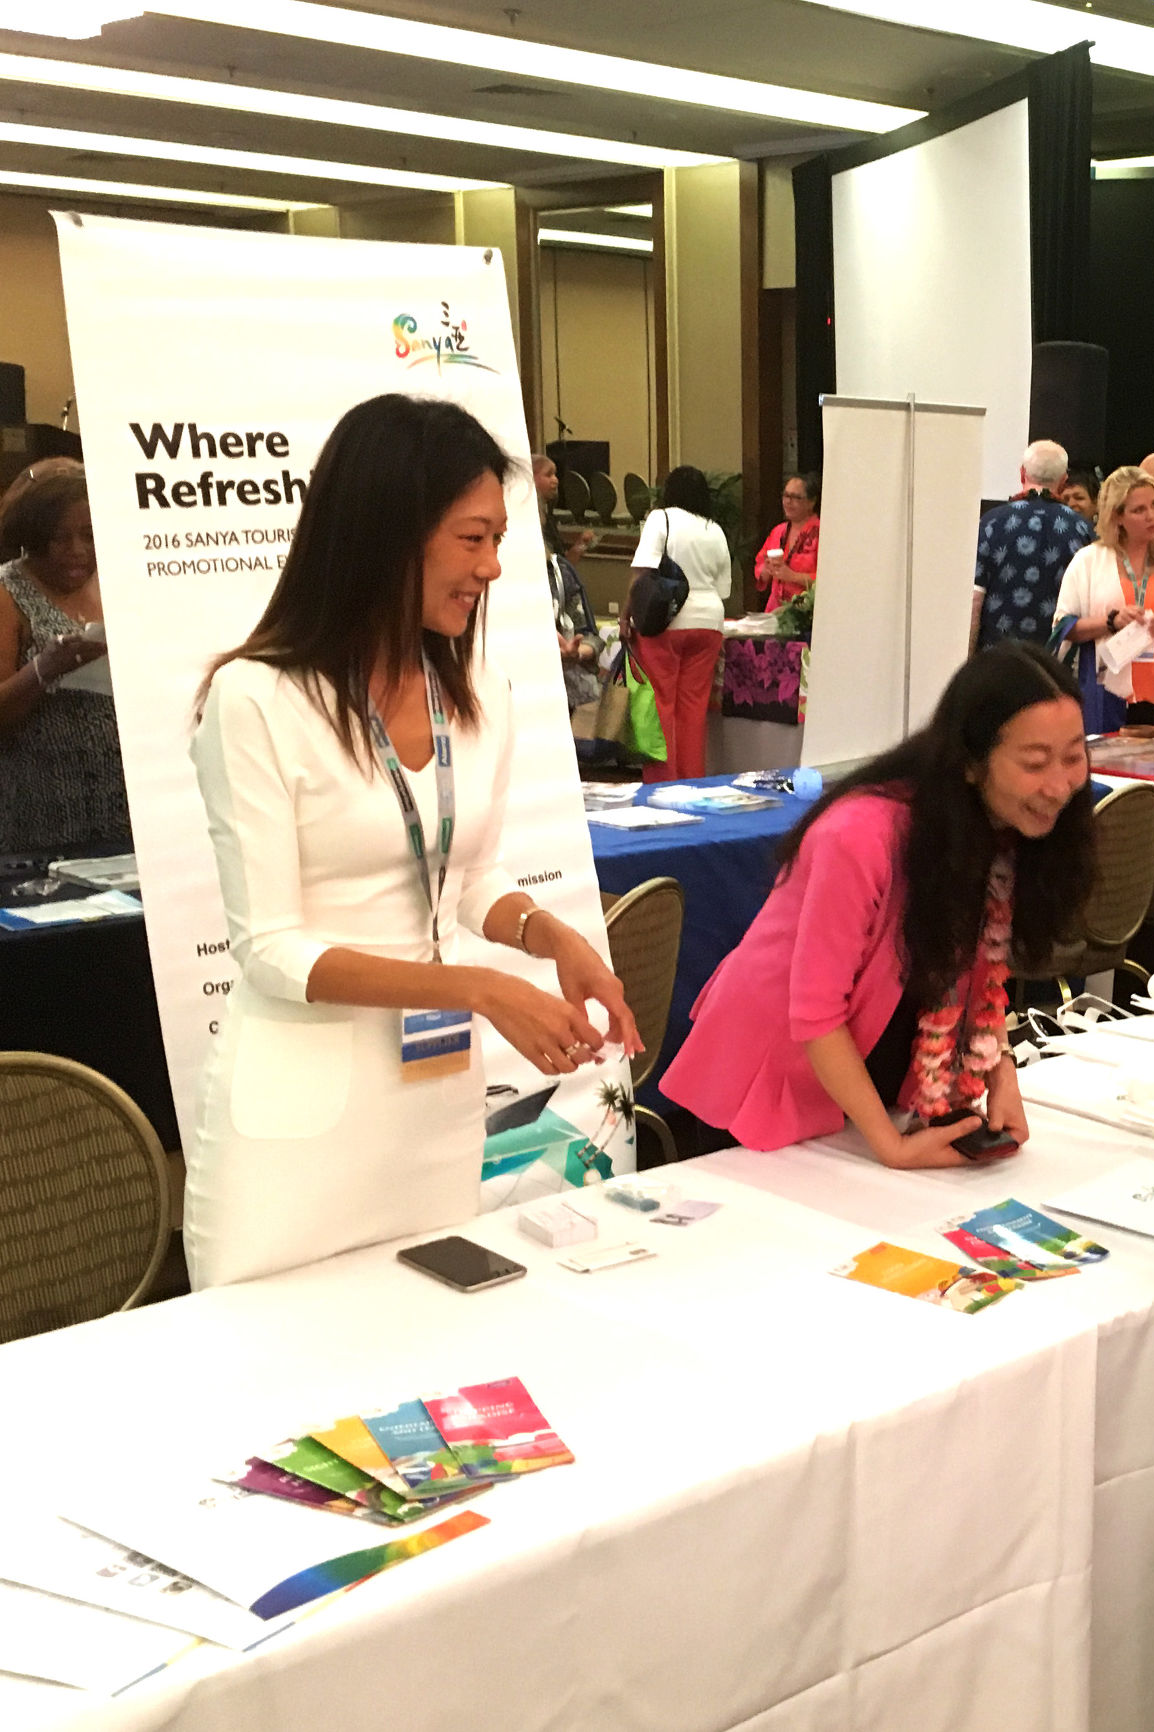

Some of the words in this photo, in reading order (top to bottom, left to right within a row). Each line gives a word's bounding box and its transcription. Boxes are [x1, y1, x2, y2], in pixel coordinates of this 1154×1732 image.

[392, 313, 455, 376] Sanya
[128, 422, 290, 460] Where
[134, 468, 314, 510] Refresh
[143, 534, 181, 550] 2016
[185, 531, 241, 548] SANYA
[146, 556, 273, 577] PROMOTIONAL
